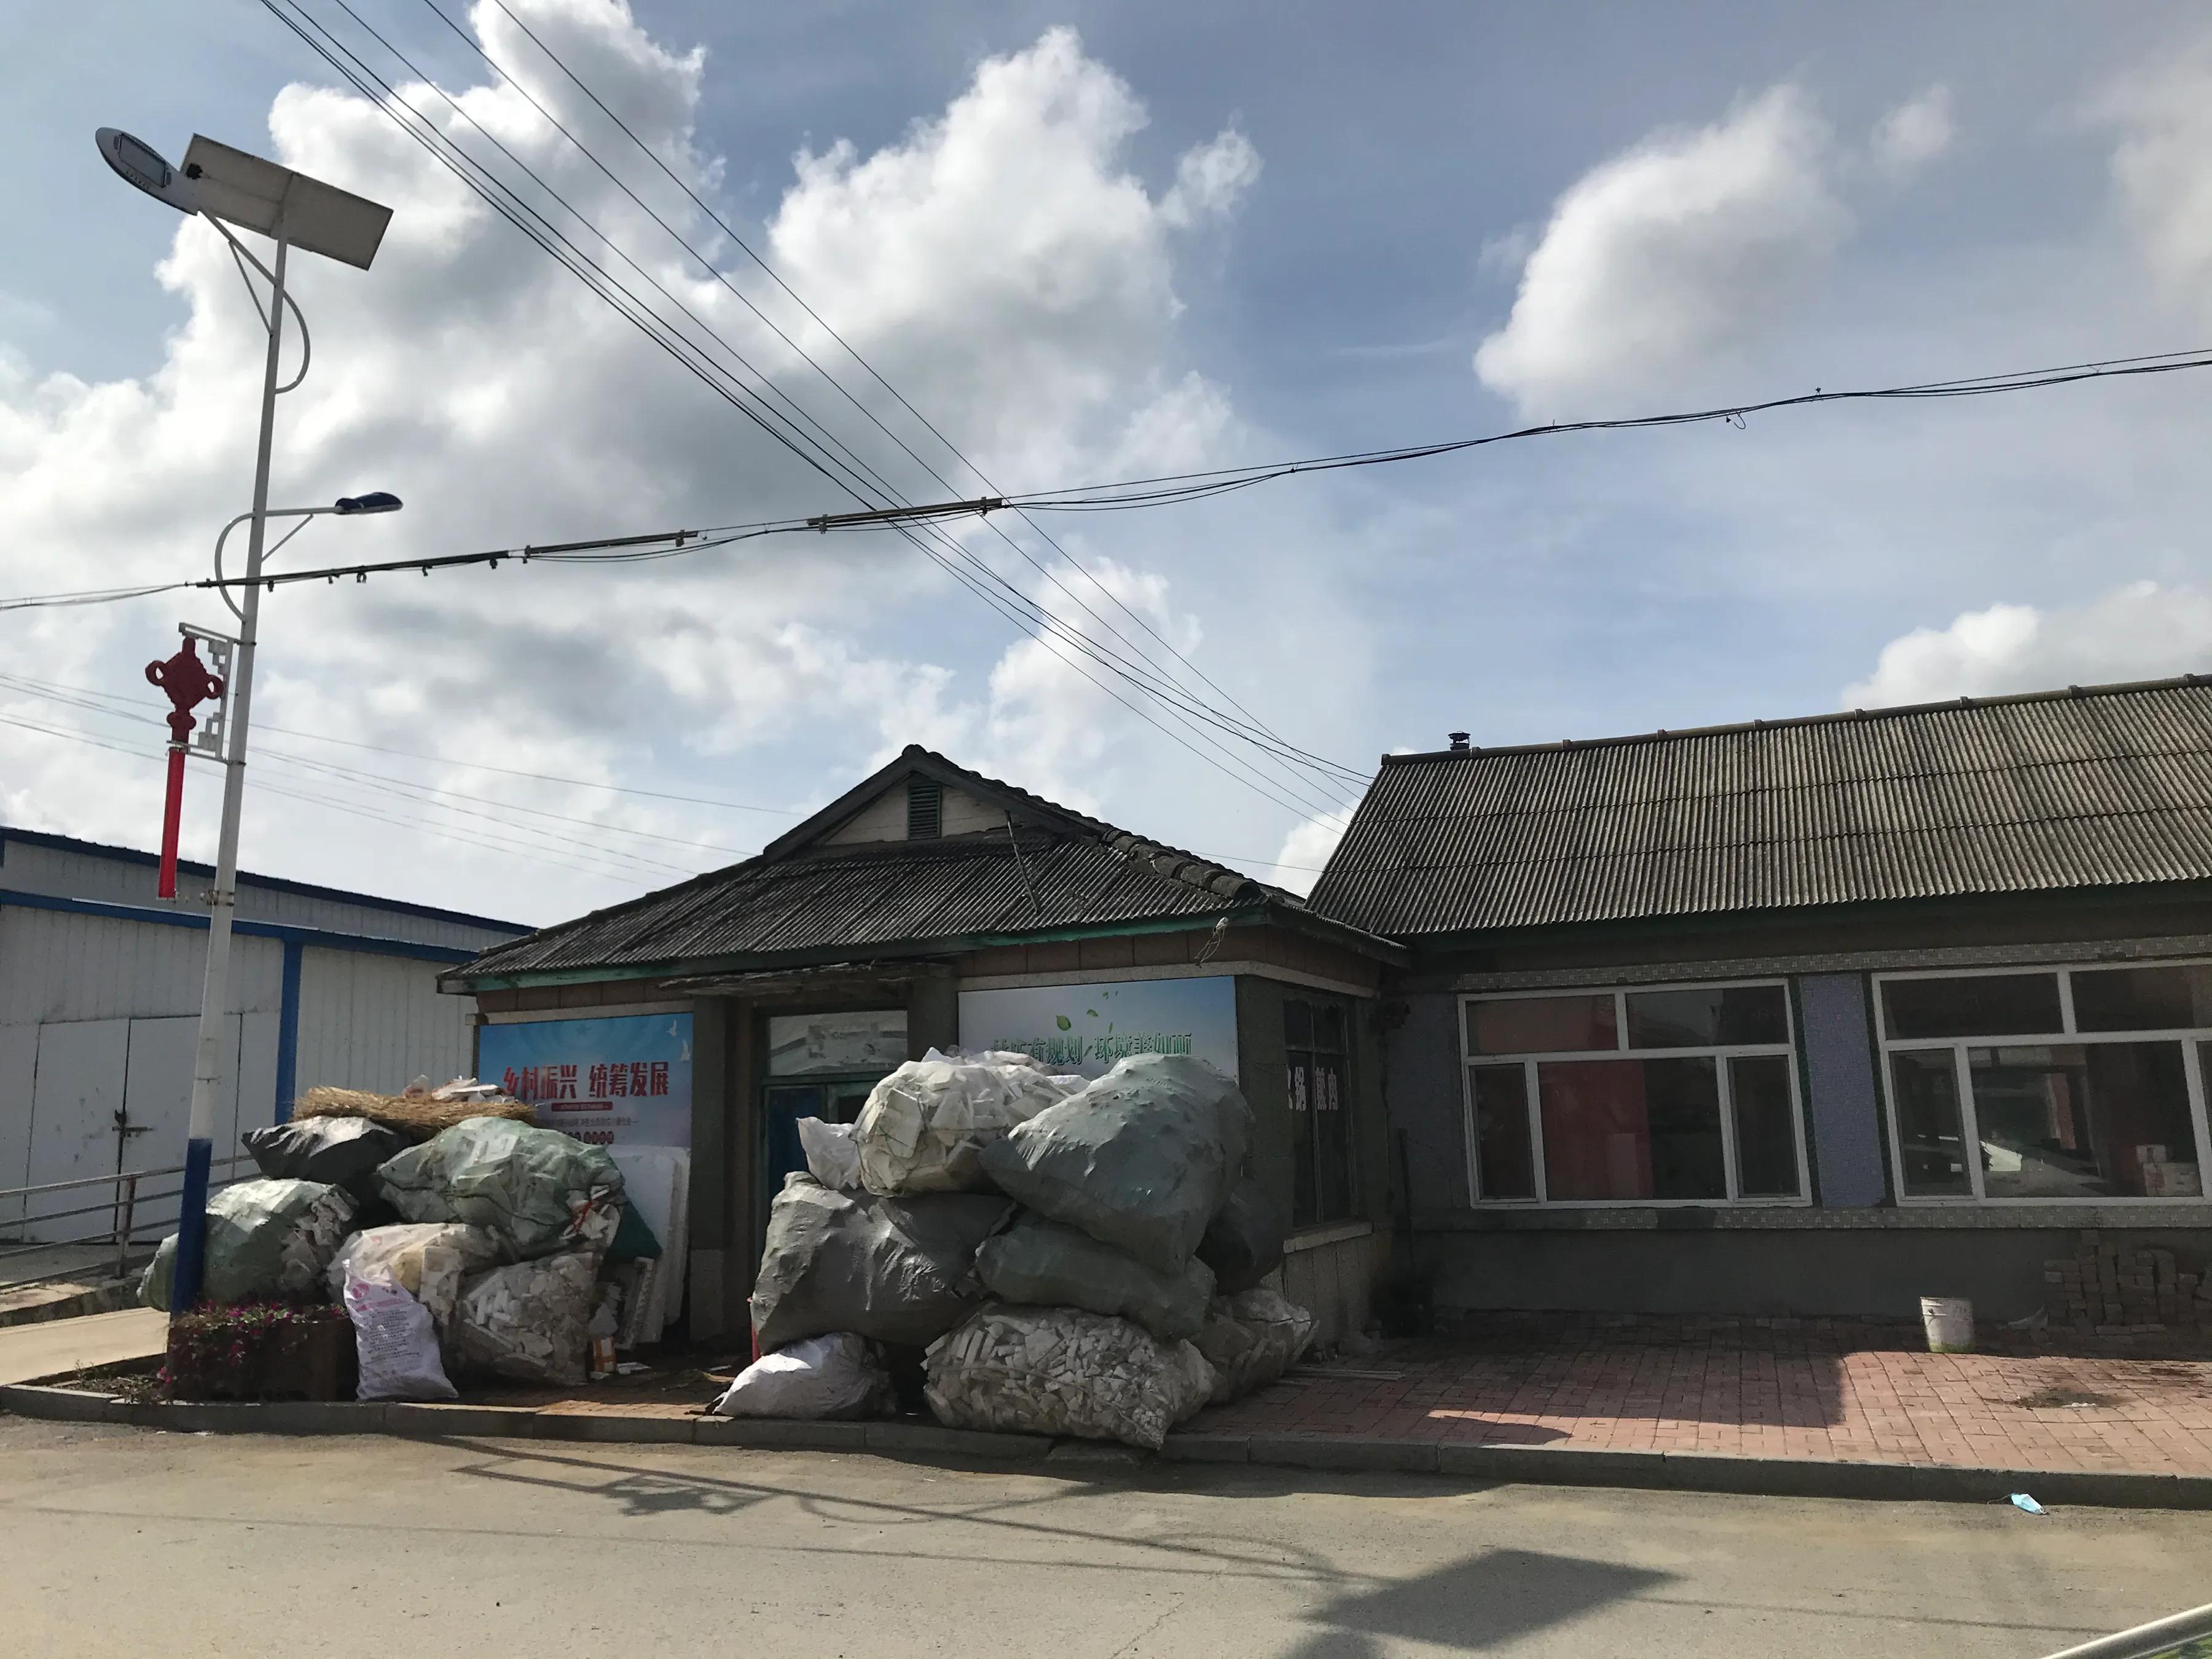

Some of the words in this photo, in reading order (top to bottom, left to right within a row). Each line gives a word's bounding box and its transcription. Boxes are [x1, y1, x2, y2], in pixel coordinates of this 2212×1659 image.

[503, 1064, 578, 1100] 乡村振兴
[589, 1061, 669, 1097] 统筹发展
